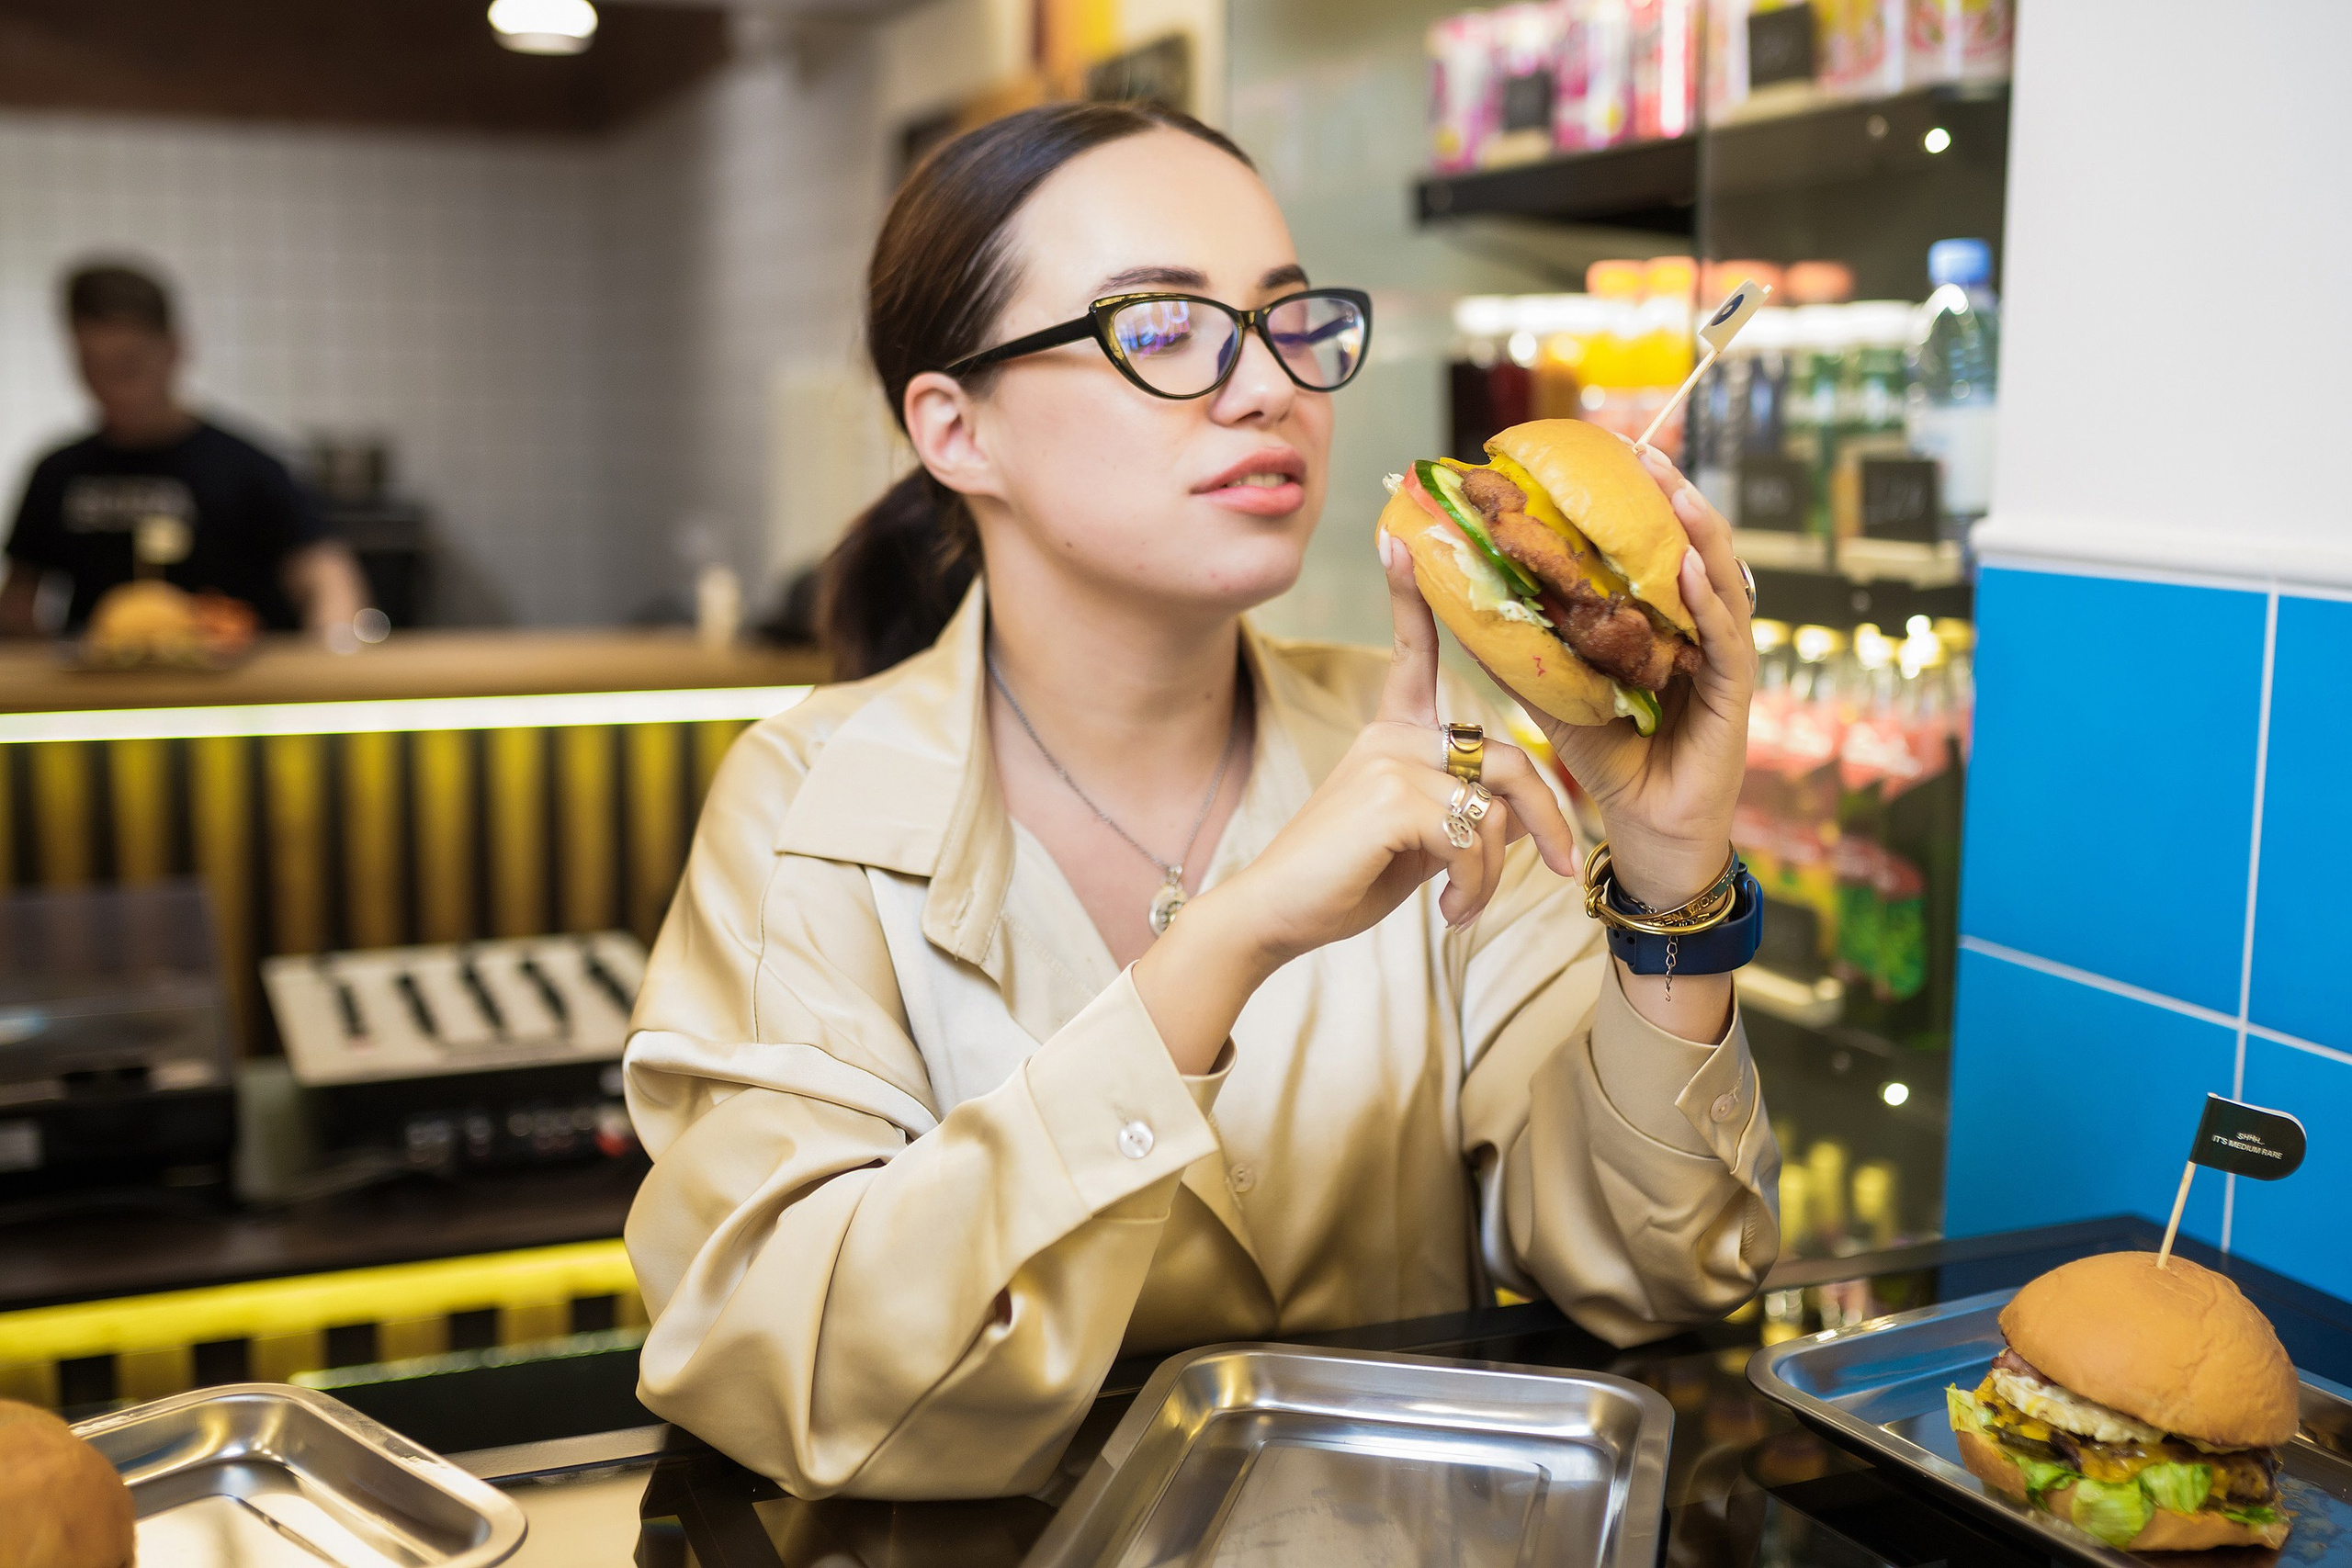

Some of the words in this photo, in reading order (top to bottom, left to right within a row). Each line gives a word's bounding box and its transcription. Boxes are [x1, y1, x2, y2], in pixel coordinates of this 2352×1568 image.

[2211, 1134, 2228, 1145] IT'S
[2228, 1139, 2261, 1155] MEDIUM
[2261, 1148, 2283, 1160] RARE
